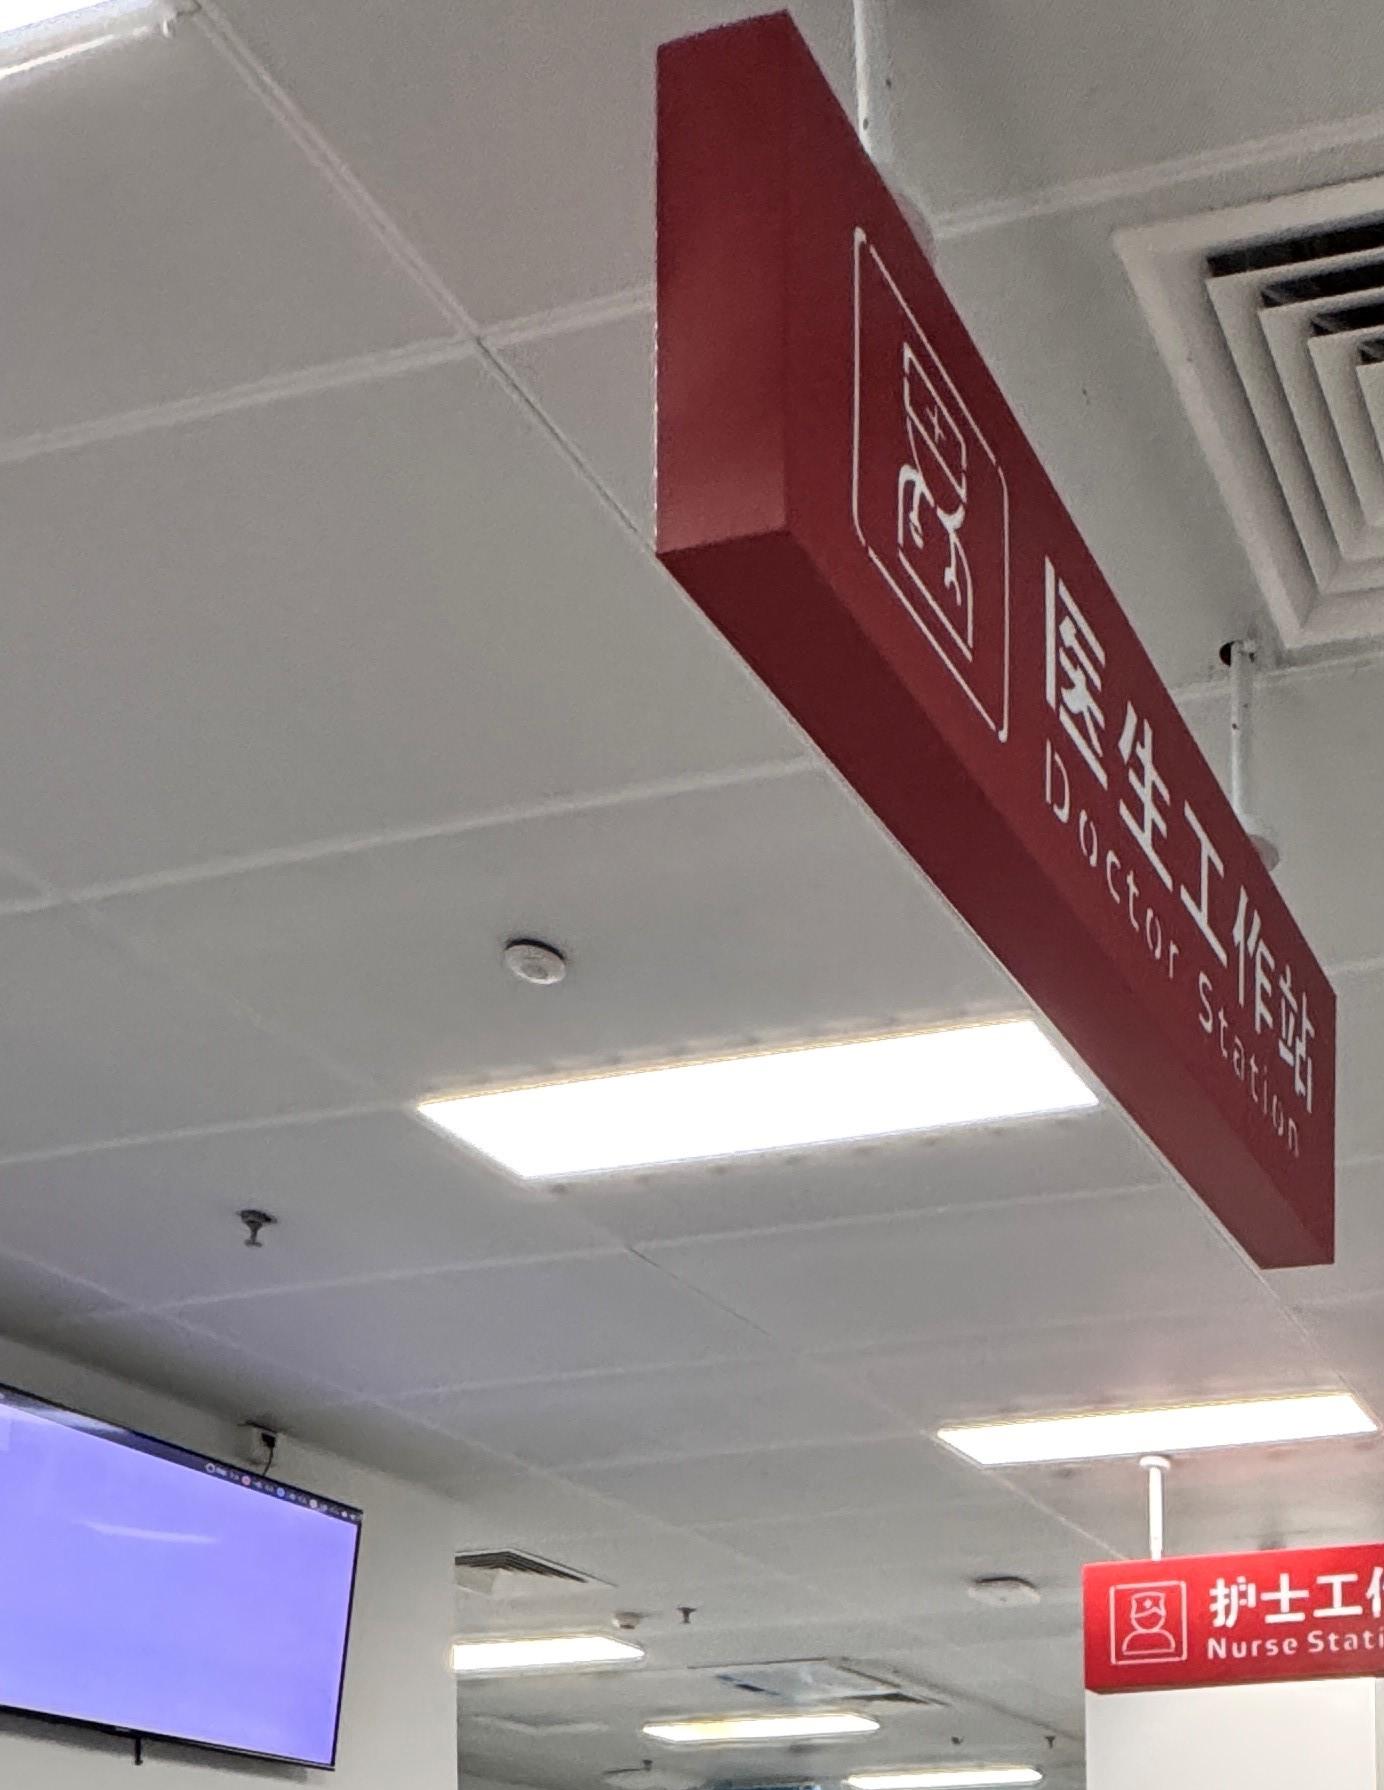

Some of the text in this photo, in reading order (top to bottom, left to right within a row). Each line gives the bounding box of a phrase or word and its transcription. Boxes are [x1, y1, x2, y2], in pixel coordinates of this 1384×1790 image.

[1045, 555, 1315, 1114] 医生工作站
[1046, 737, 1299, 1159] Doctor Station
[1207, 1633, 1299, 1660] Nurse
